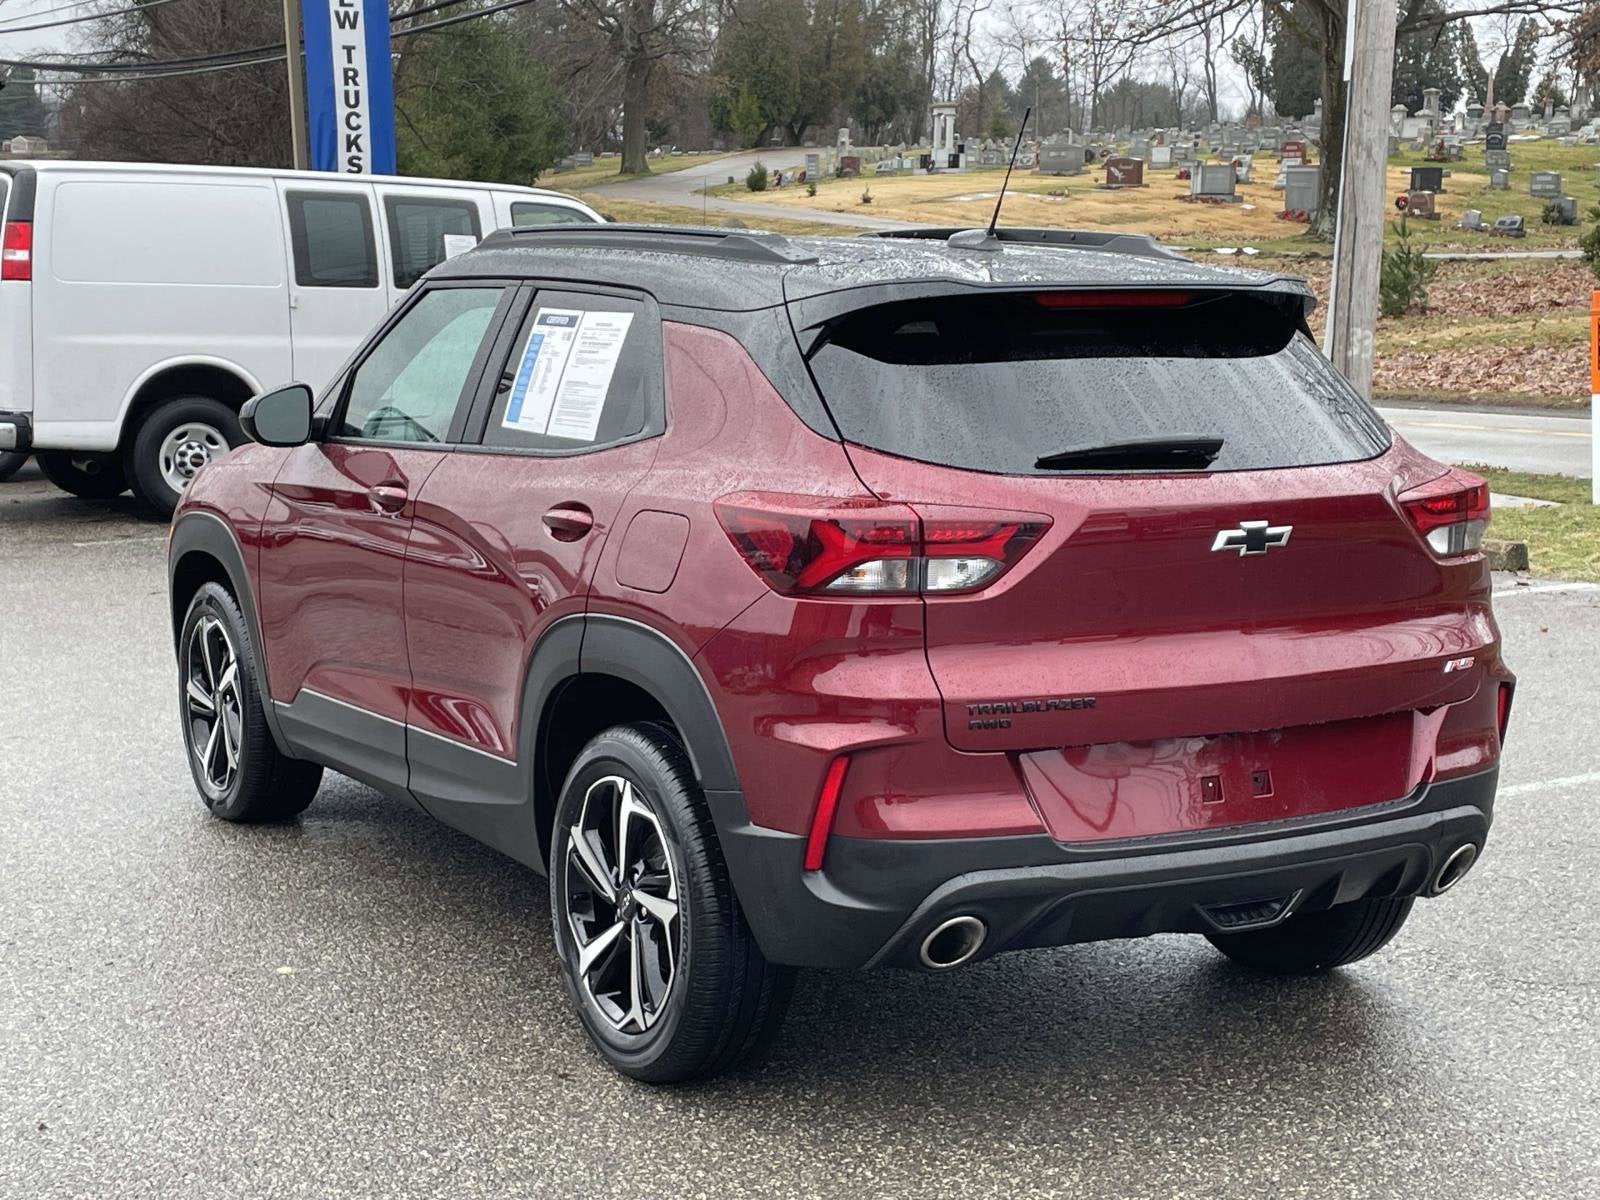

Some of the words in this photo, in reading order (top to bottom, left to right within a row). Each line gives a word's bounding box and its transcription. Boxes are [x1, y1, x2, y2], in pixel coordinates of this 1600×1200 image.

[342, 45, 364, 174] TRUCKS
[1444, 657, 1475, 673] RS
[966, 696, 1096, 716] TRAILBLAZER
[968, 718, 1012, 731] AWD
